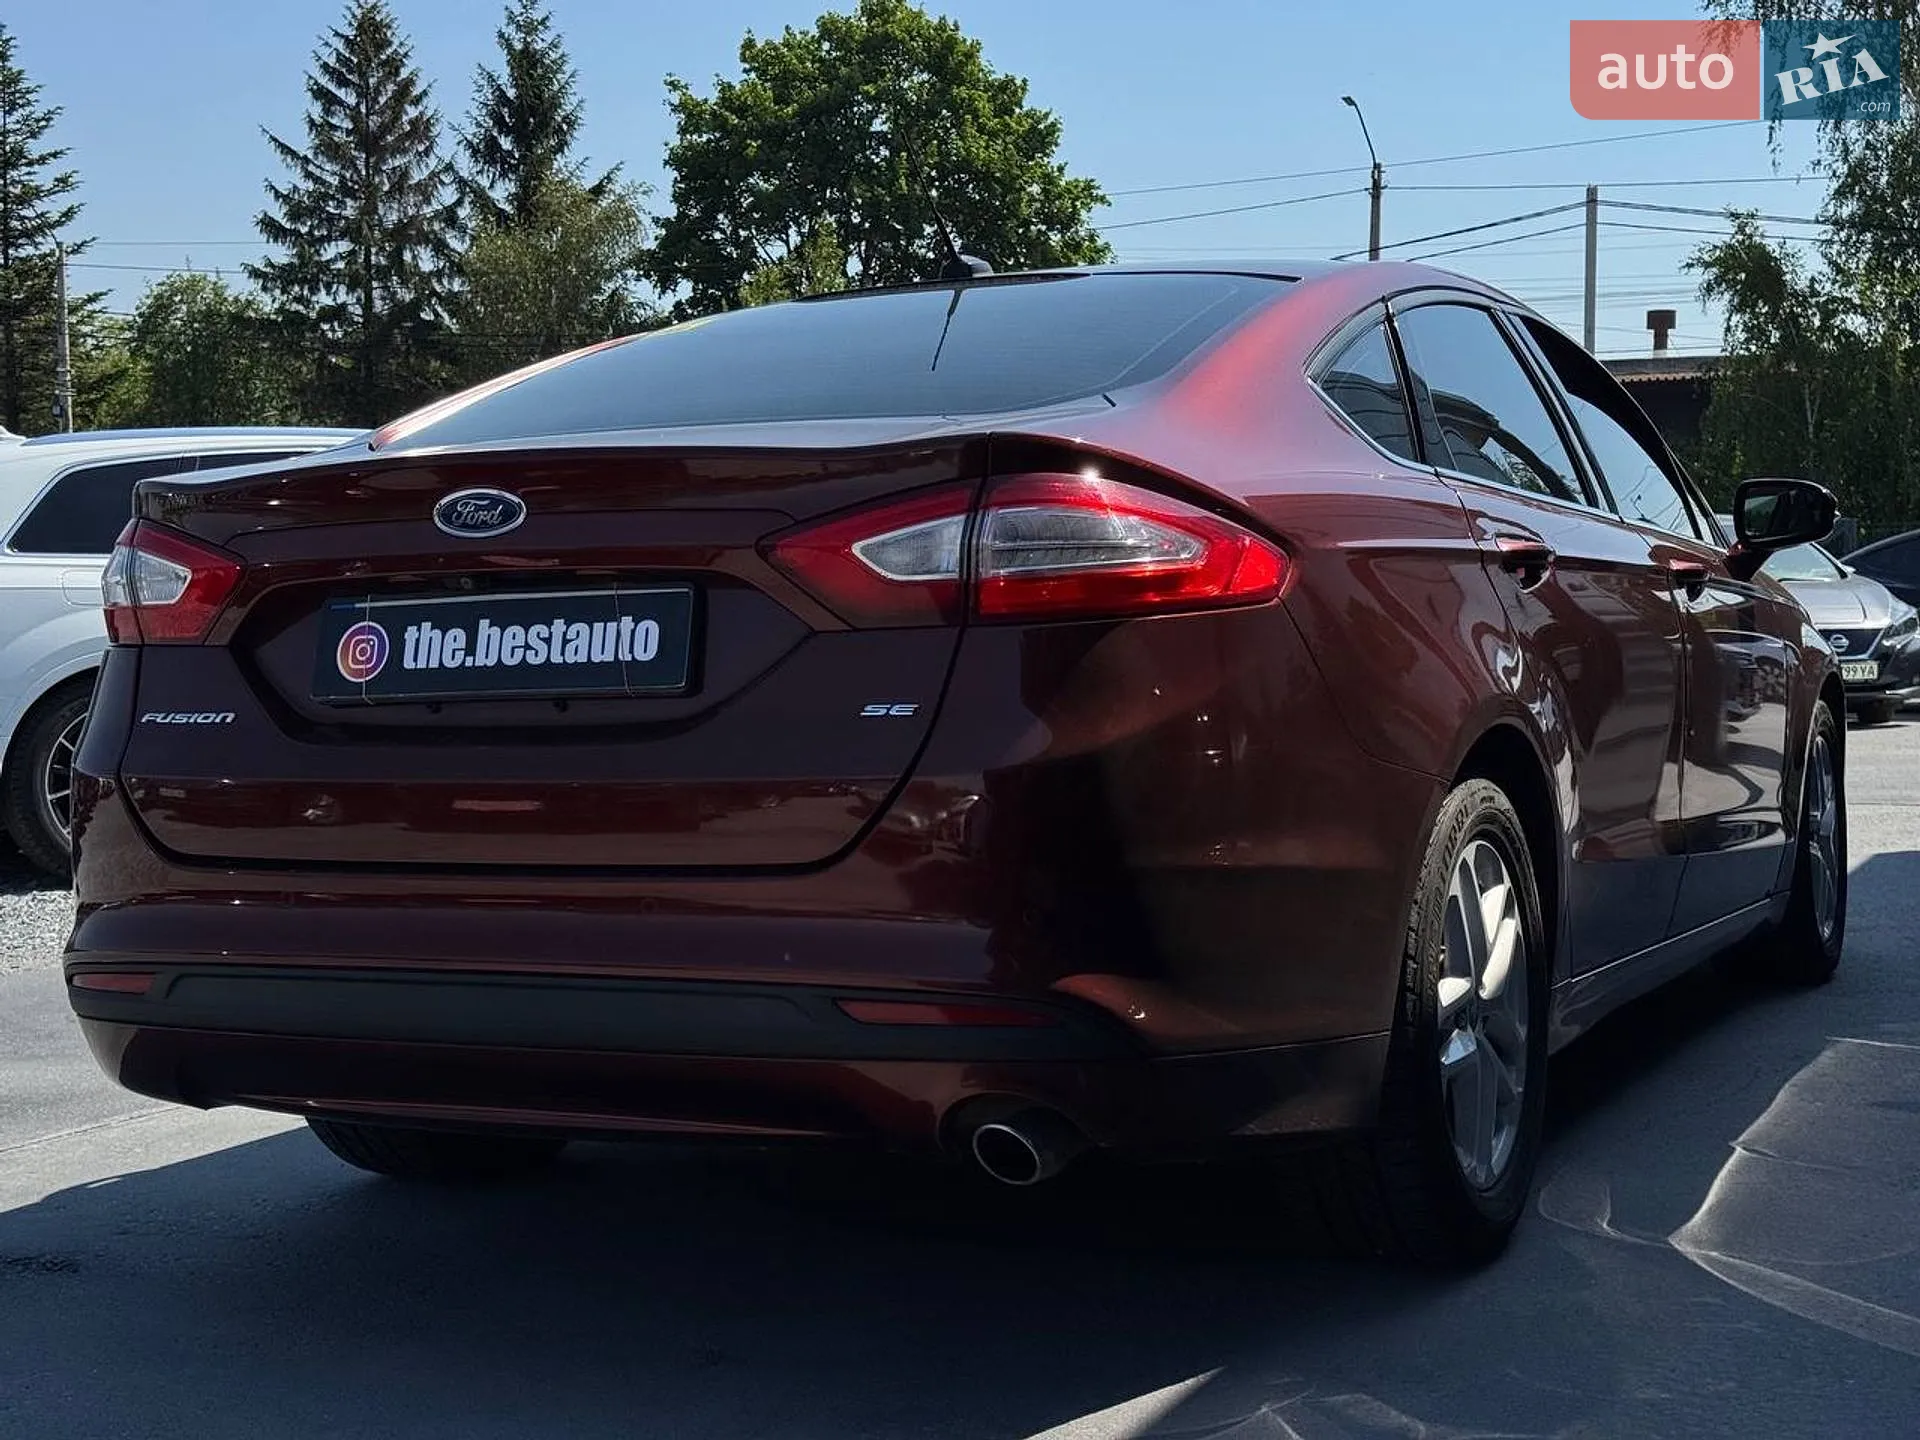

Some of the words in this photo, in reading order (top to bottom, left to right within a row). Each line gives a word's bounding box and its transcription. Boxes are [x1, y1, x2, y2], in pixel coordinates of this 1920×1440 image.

[451, 499, 504, 525] Ford
[403, 616, 660, 669] the.bestauto
[141, 712, 236, 723] FUSION
[860, 704, 919, 716] SE
